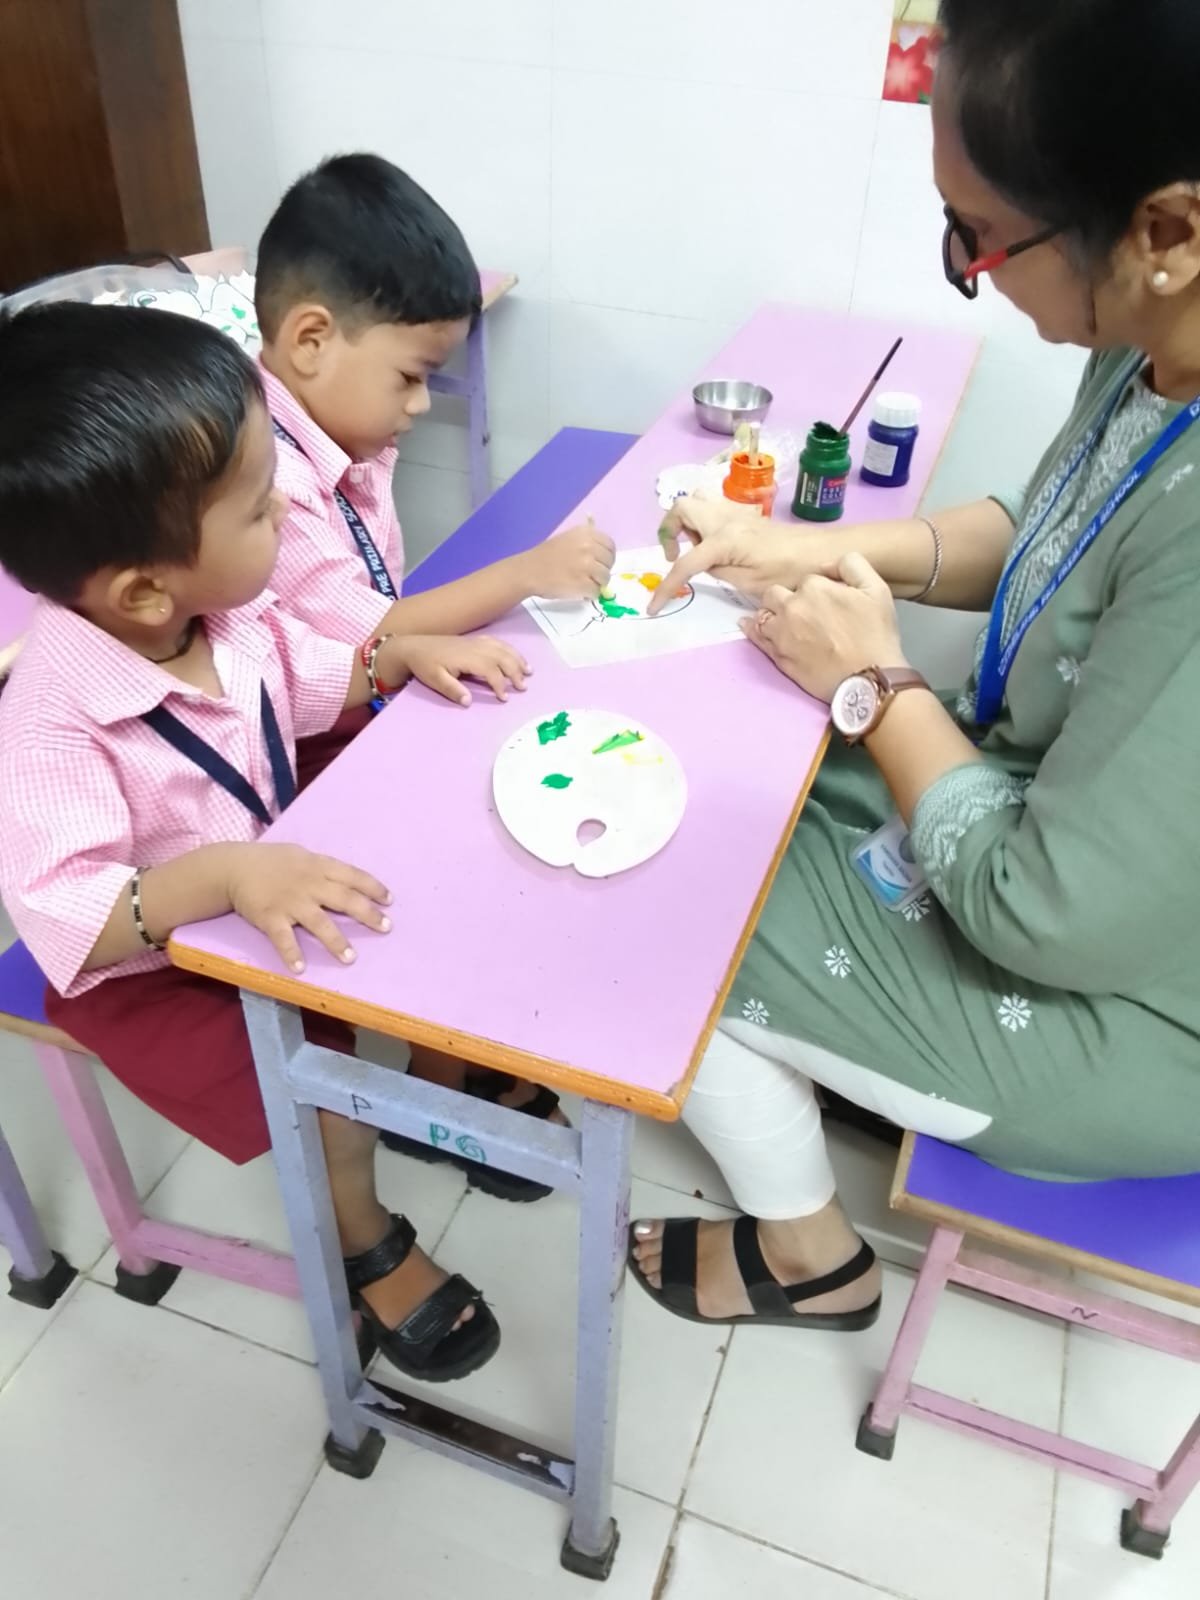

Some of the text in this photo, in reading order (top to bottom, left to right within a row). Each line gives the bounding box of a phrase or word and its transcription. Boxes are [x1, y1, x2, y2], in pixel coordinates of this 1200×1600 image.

[1100, 471, 1142, 524] SCHOOL
[354, 526, 382, 572] PRIMARY
[375, 572, 392, 593] PRE
[351, 1094, 372, 1115] P
